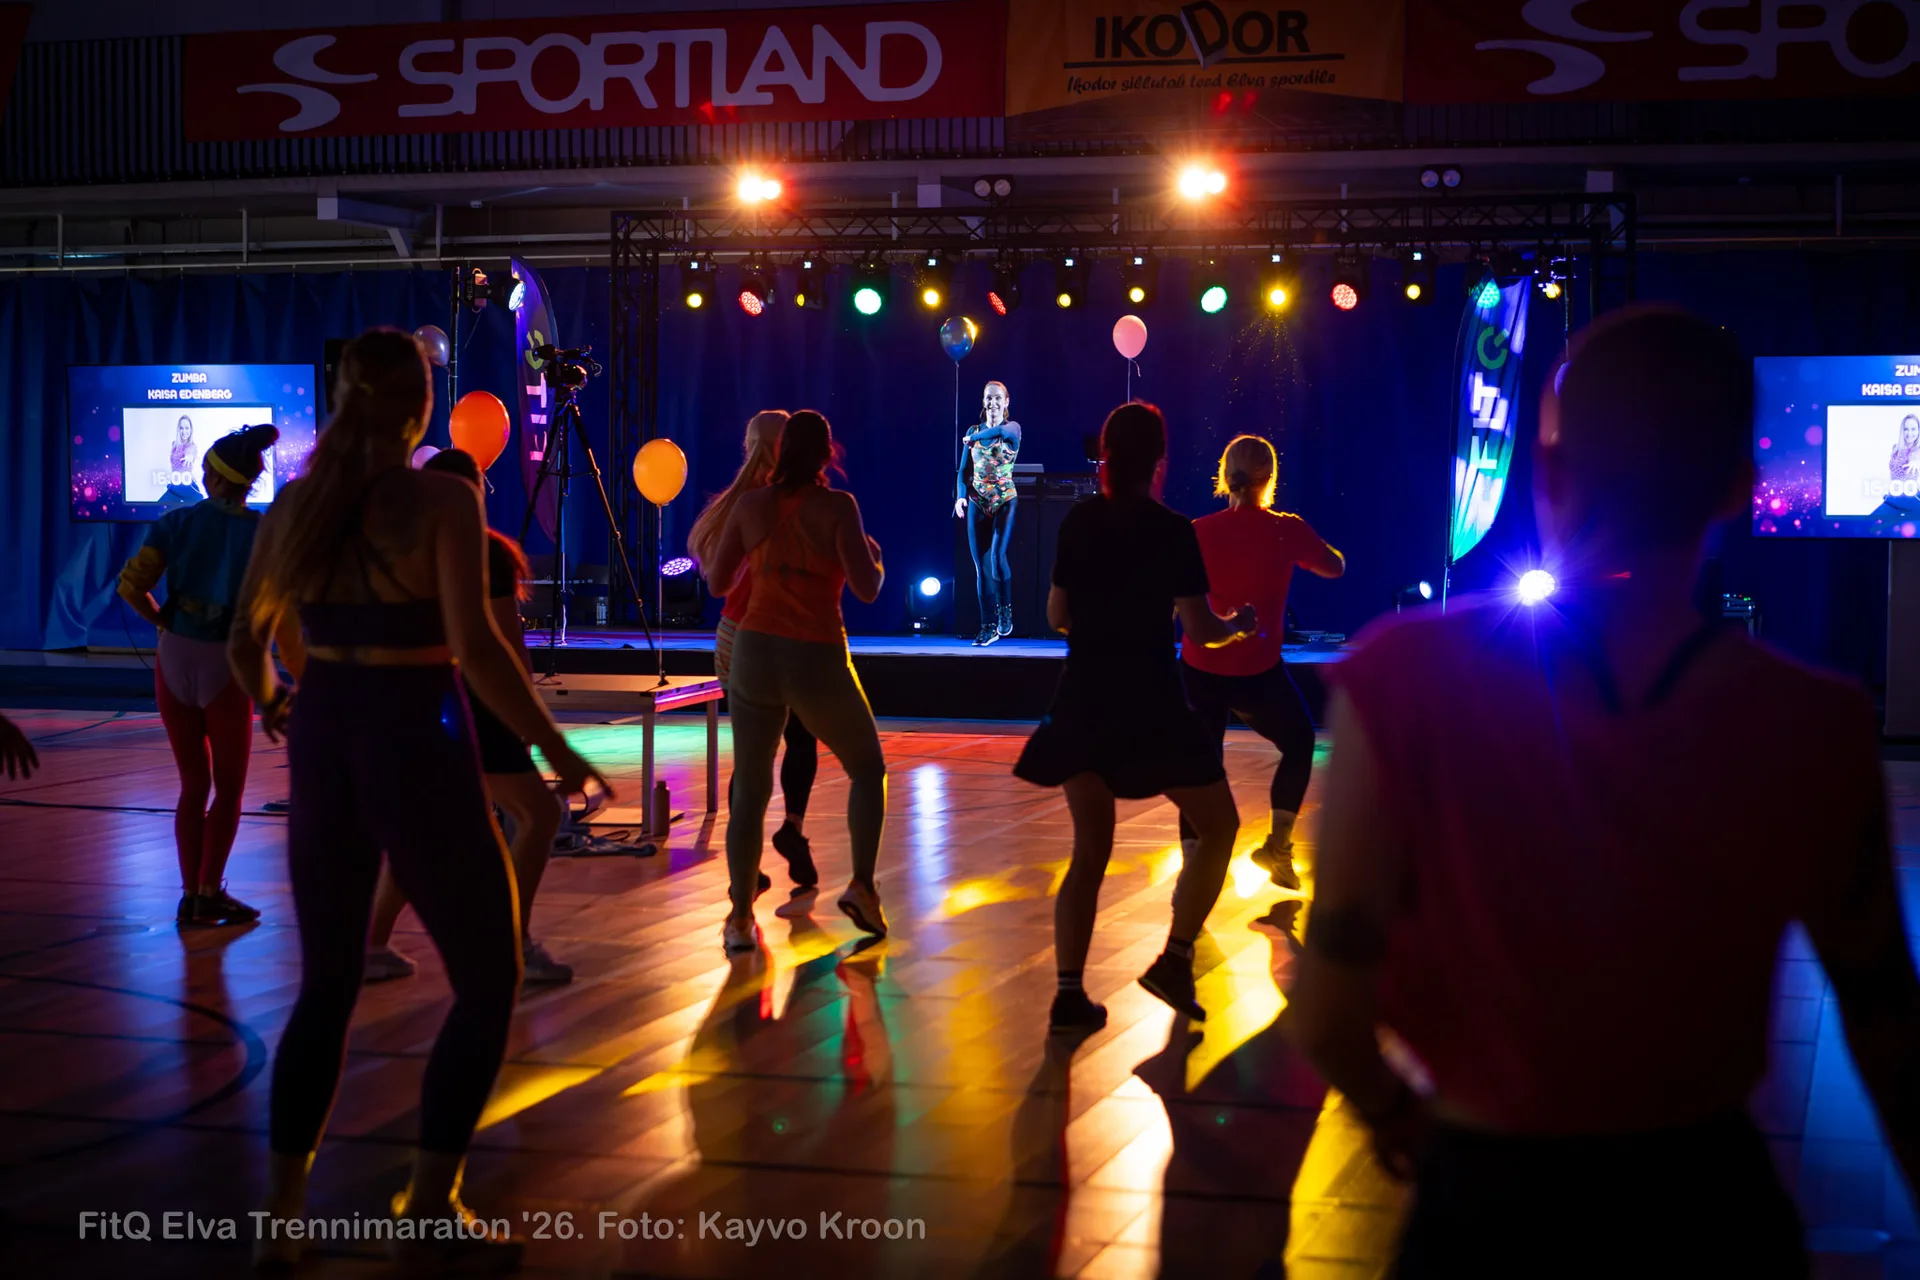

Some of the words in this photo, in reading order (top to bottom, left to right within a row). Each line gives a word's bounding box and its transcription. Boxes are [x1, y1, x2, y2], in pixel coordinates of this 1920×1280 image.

[1094, 1, 1311, 64] IKODOR
[1677, 0, 1920, 82] SPO
[397, 20, 944, 118] SPORTLAND
[1067, 75, 1117, 95] Ikodor
[1226, 71, 1265, 88] Elva
[171, 372, 207, 384] ZUMBA
[147, 389, 178, 400] KAISA
[179, 389, 233, 400] EDENBERG
[1861, 383, 1903, 396] KAISA
[1904, 383, 1920, 396] ED
[152, 470, 193, 486] 16:00
[1863, 479, 1918, 496] 16:00
